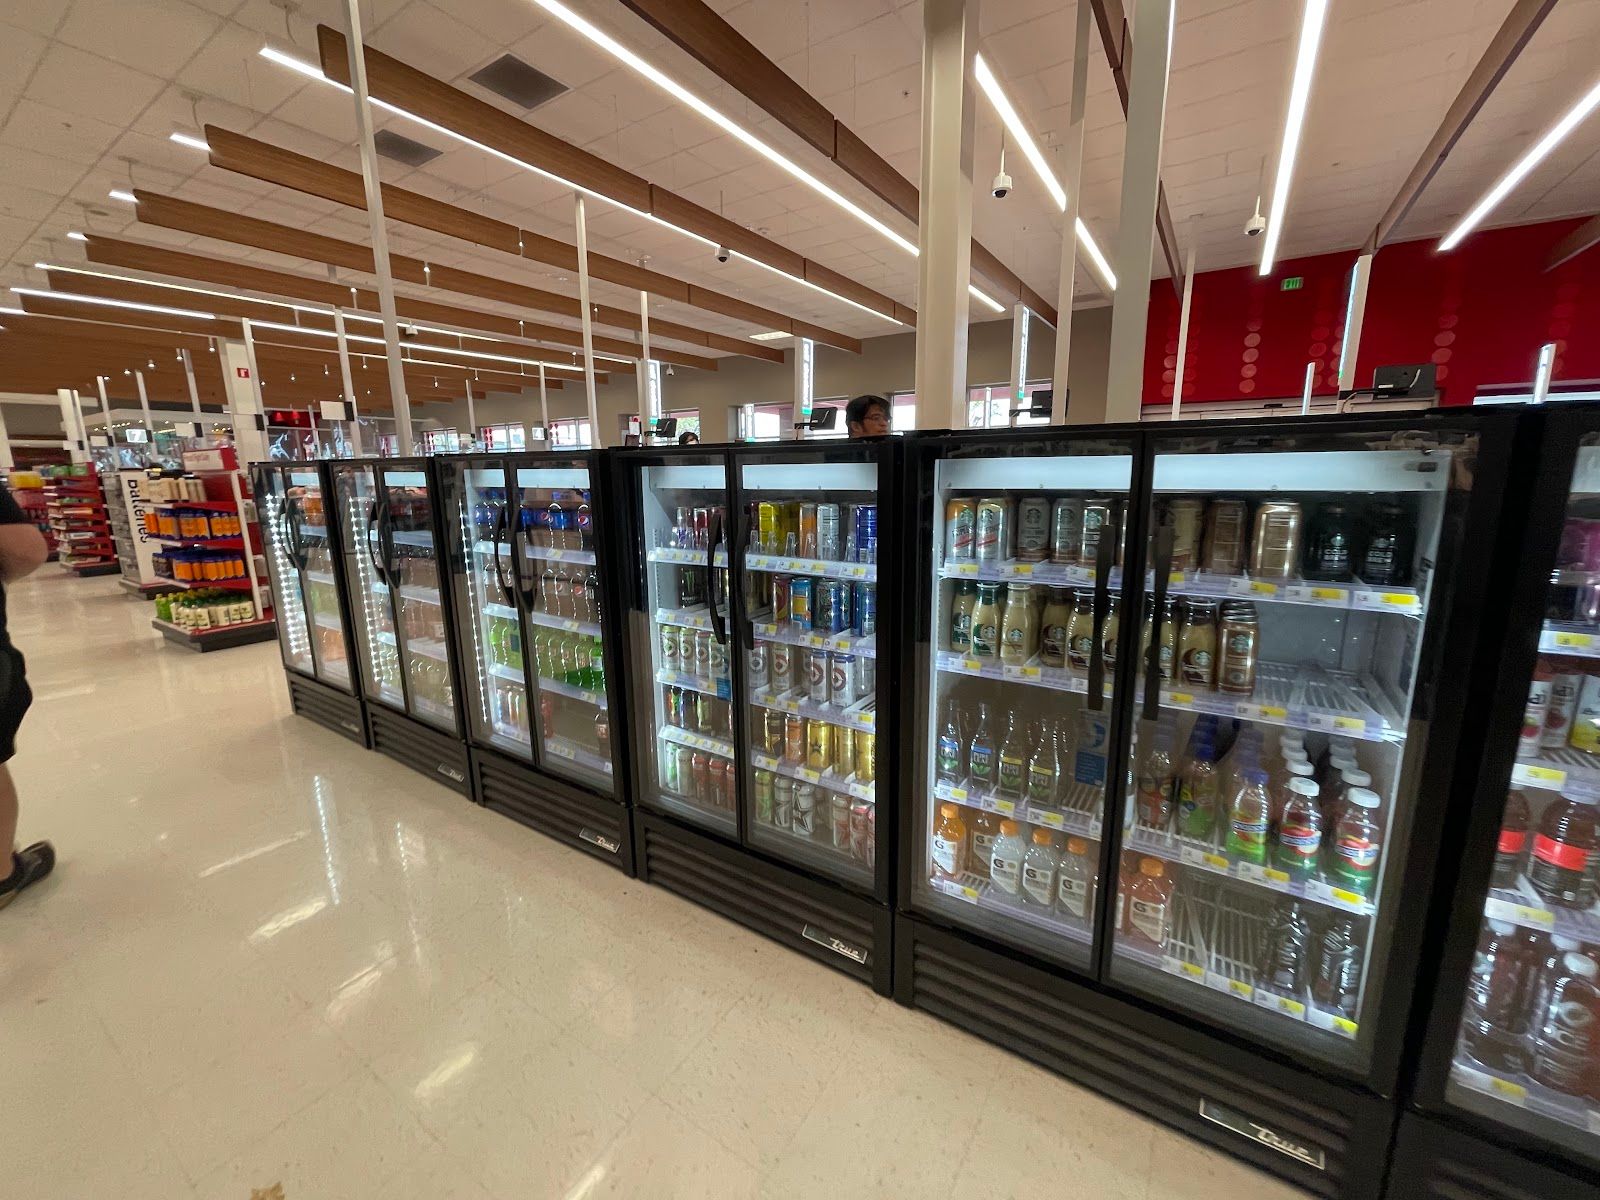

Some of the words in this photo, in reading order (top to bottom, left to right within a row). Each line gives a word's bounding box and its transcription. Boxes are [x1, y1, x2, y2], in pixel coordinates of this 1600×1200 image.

[934, 840, 945, 850] G
[976, 835, 985, 844] G
[993, 858, 1004, 869] G
[1025, 868, 1037, 879] G
[1062, 879, 1073, 890] G
[1134, 901, 1148, 913] G
